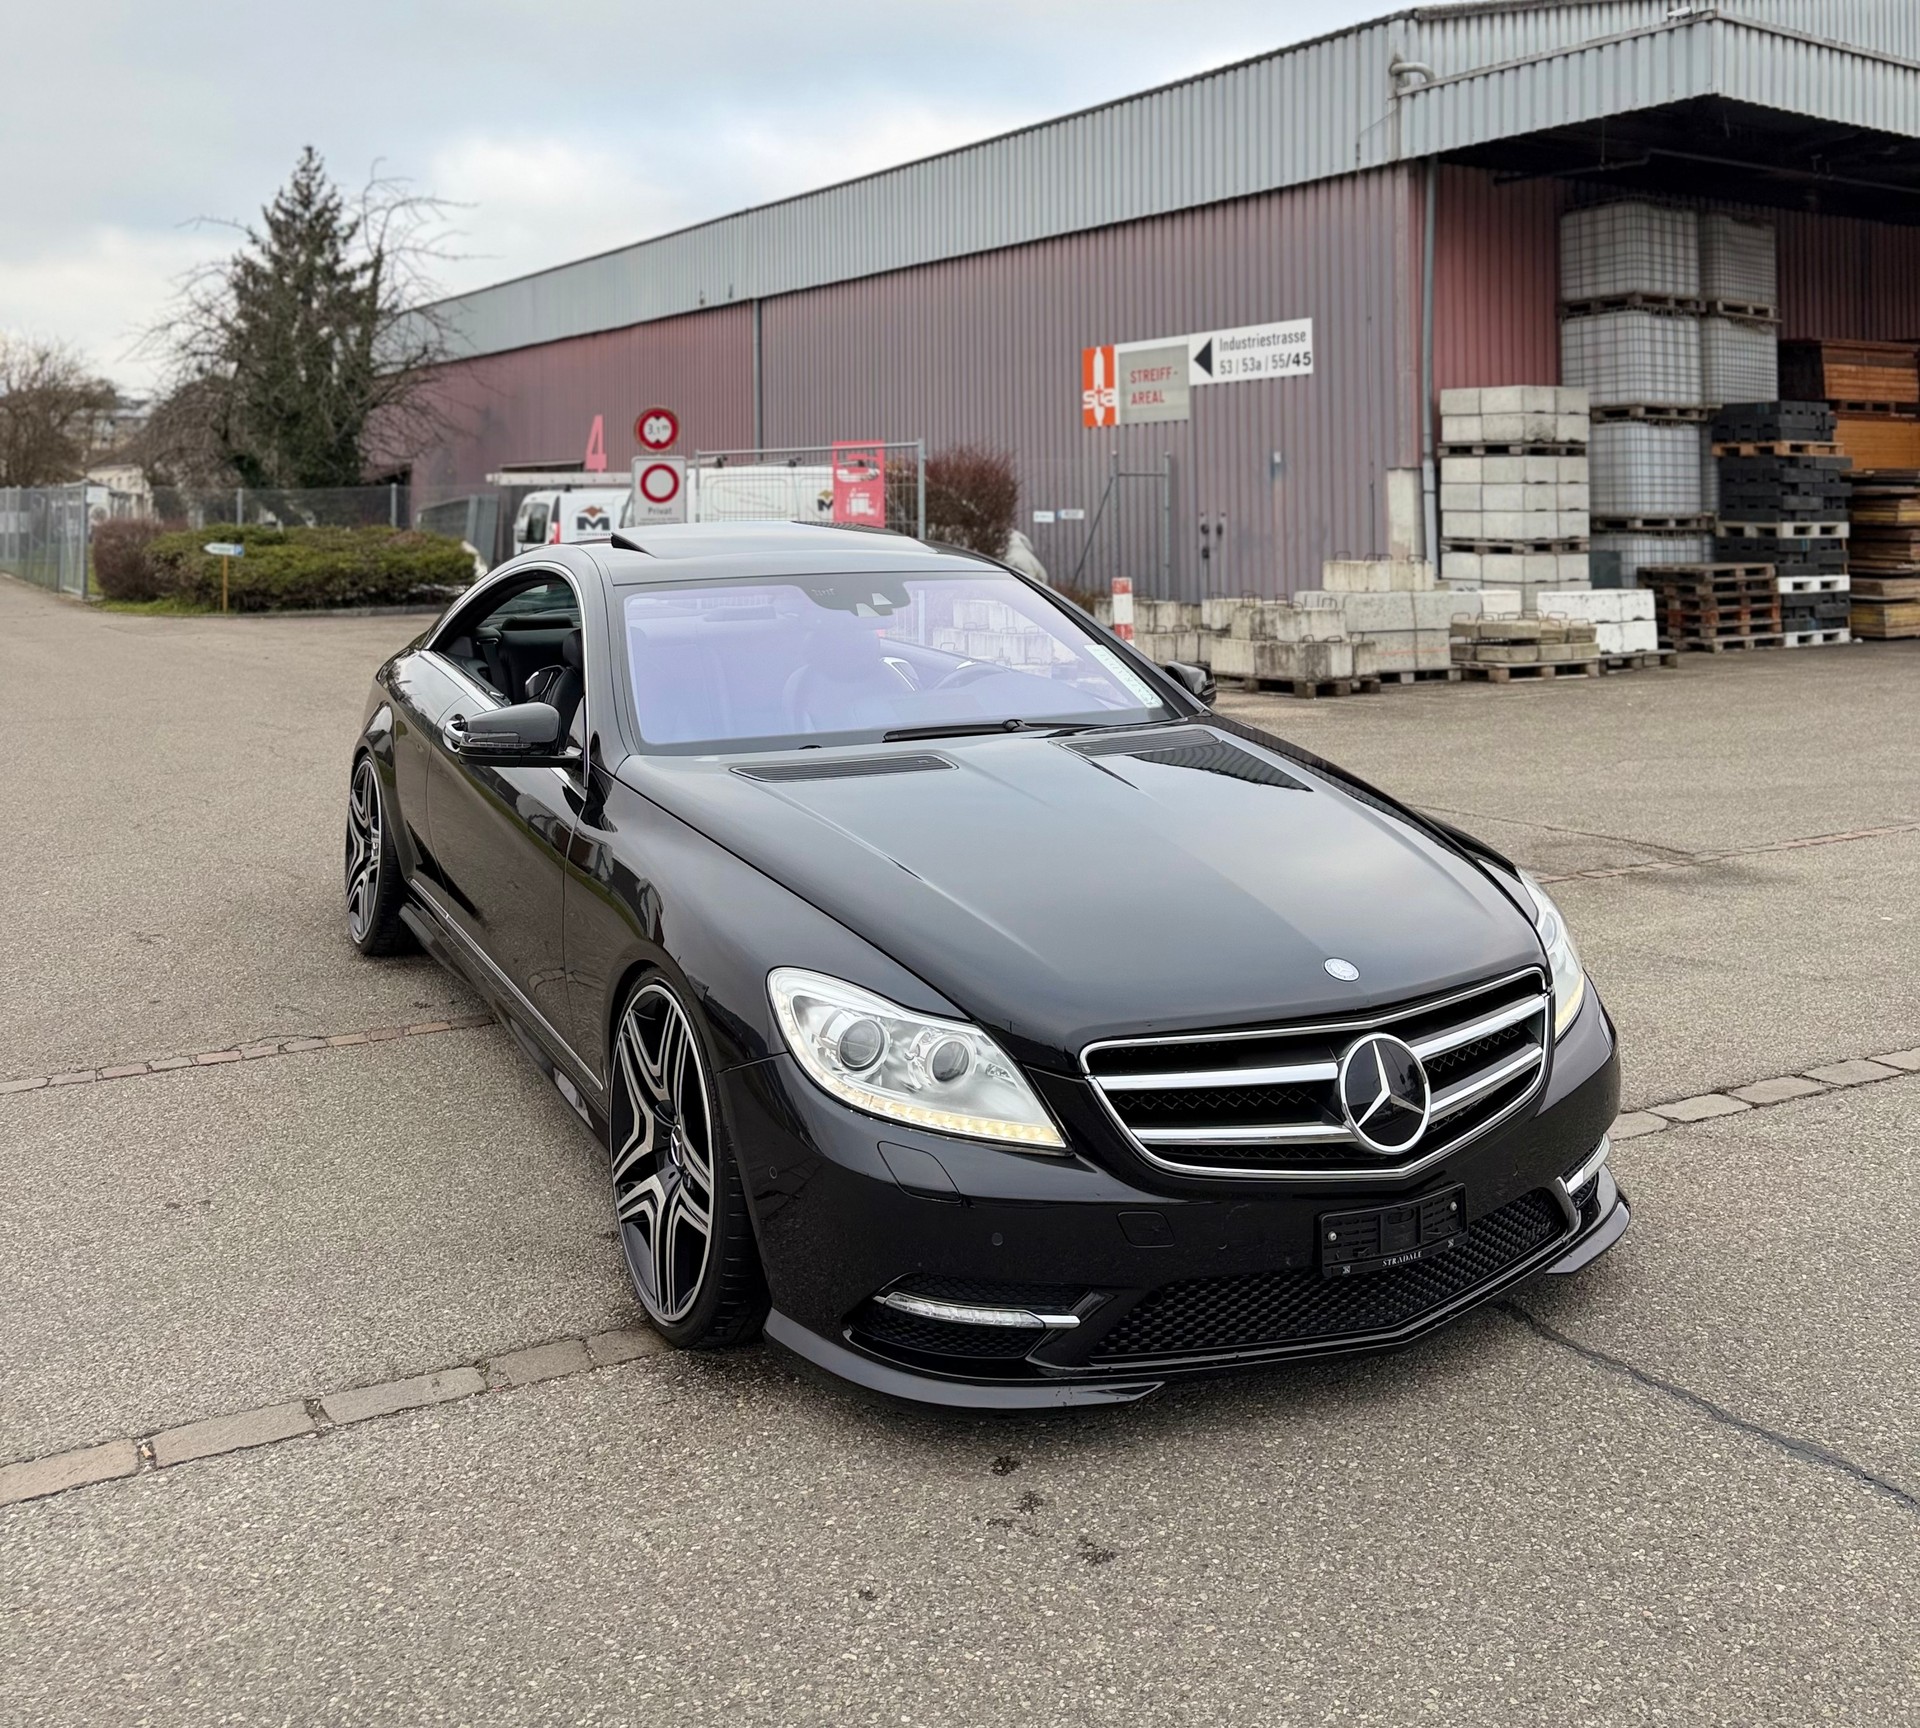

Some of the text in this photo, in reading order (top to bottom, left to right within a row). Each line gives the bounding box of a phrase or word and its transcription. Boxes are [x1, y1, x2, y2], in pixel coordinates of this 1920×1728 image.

[1219, 331, 1306, 352] Industriestrasse
[1219, 359, 1233, 375] 53
[1242, 356, 1262, 373] 53a
[1130, 366, 1179, 384] STREIFF-
[1131, 390, 1165, 405] AREAL
[586, 414, 608, 474] 4
[647, 506, 673, 516] Privat
[1382, 1250, 1422, 1267] STRADALE
